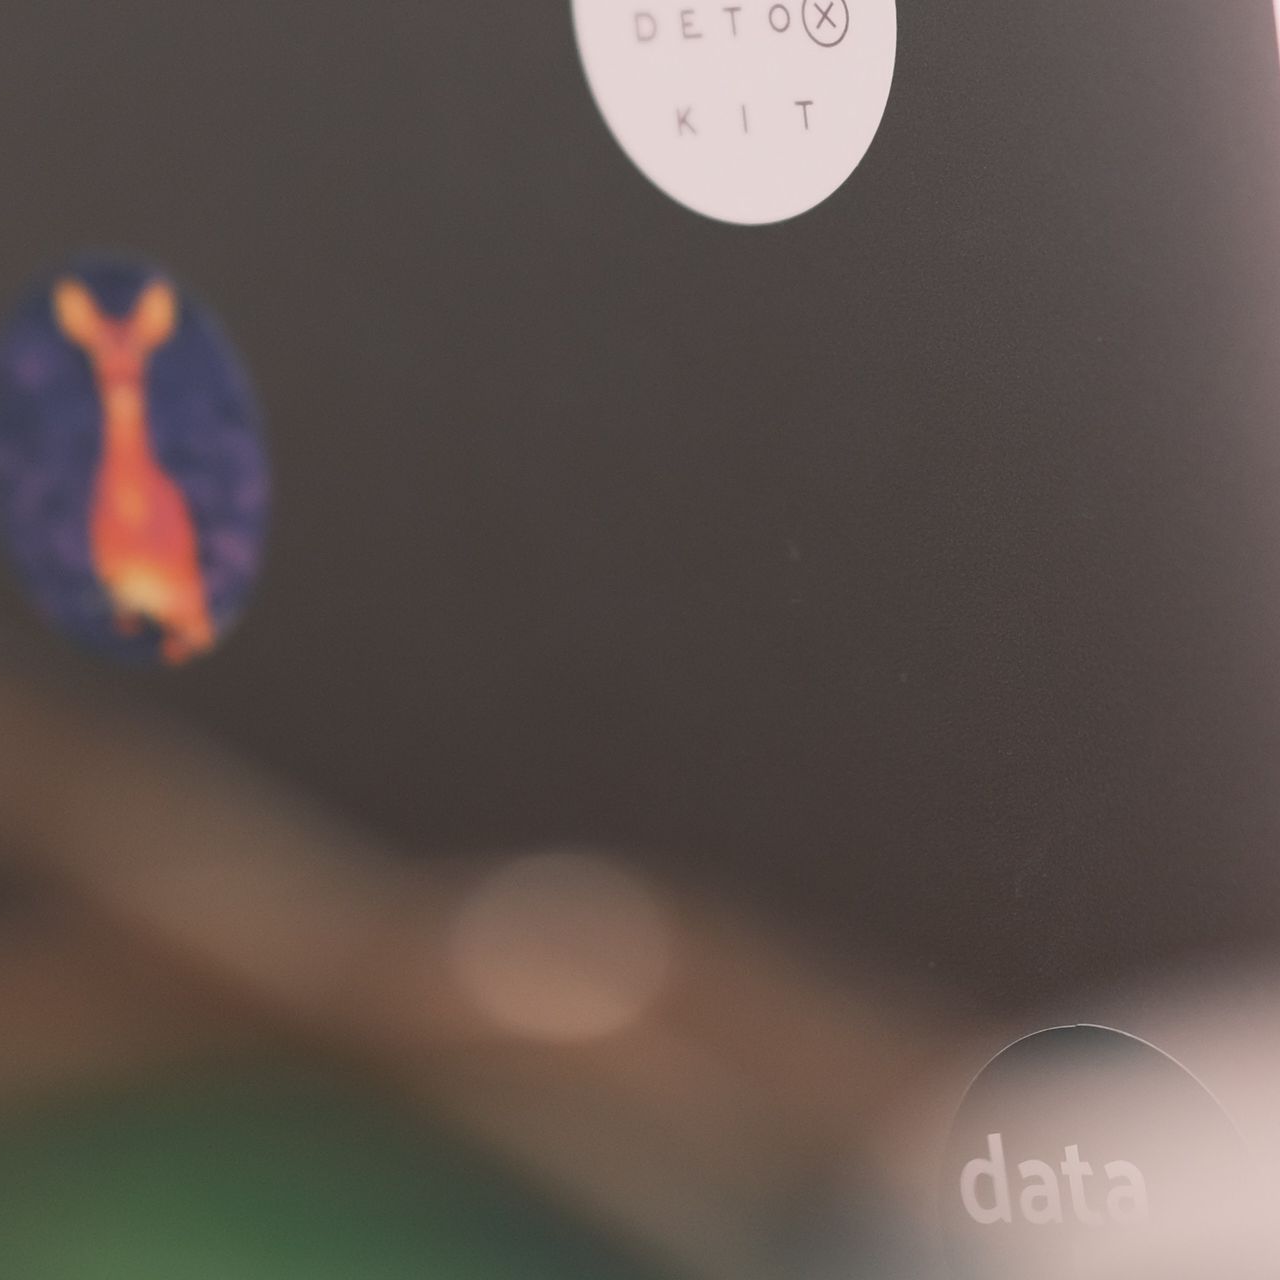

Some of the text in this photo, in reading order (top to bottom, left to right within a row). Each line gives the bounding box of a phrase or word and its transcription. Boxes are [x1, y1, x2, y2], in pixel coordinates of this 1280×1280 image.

[632, 0, 838, 42] DETOX
[674, 99, 815, 136] KIT
[959, 1132, 1150, 1226] data
